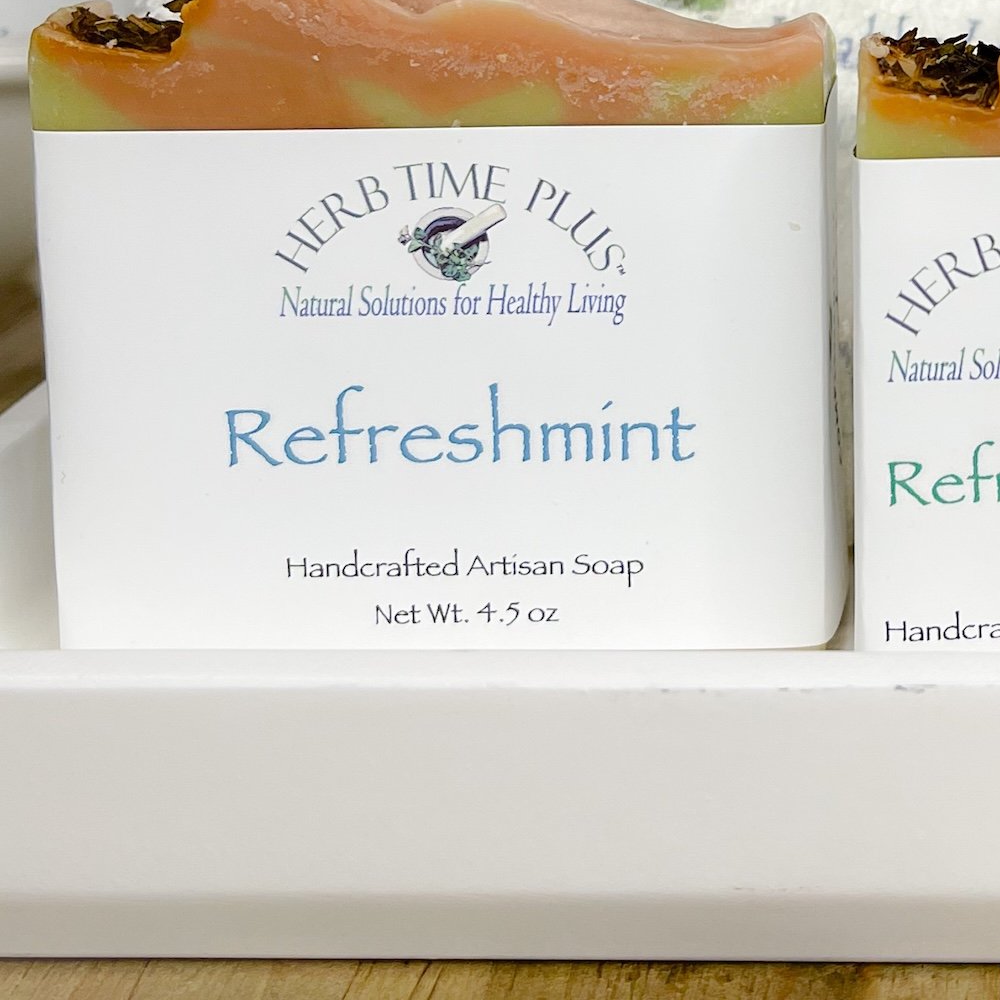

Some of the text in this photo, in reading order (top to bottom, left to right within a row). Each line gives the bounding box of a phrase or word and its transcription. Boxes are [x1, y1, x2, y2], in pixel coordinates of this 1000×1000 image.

[275, 175, 390, 274] HERB
[393, 161, 510, 205] TIME
[279, 282, 627, 327] Natural Solutions for Healthy Living
[887, 349, 966, 383] Natural
[225, 382, 697, 468] Refreshmint
[286, 548, 645, 588] Handcrafted Artisan Soap
[375, 602, 560, 626] Net Wt. 4.5 oz
